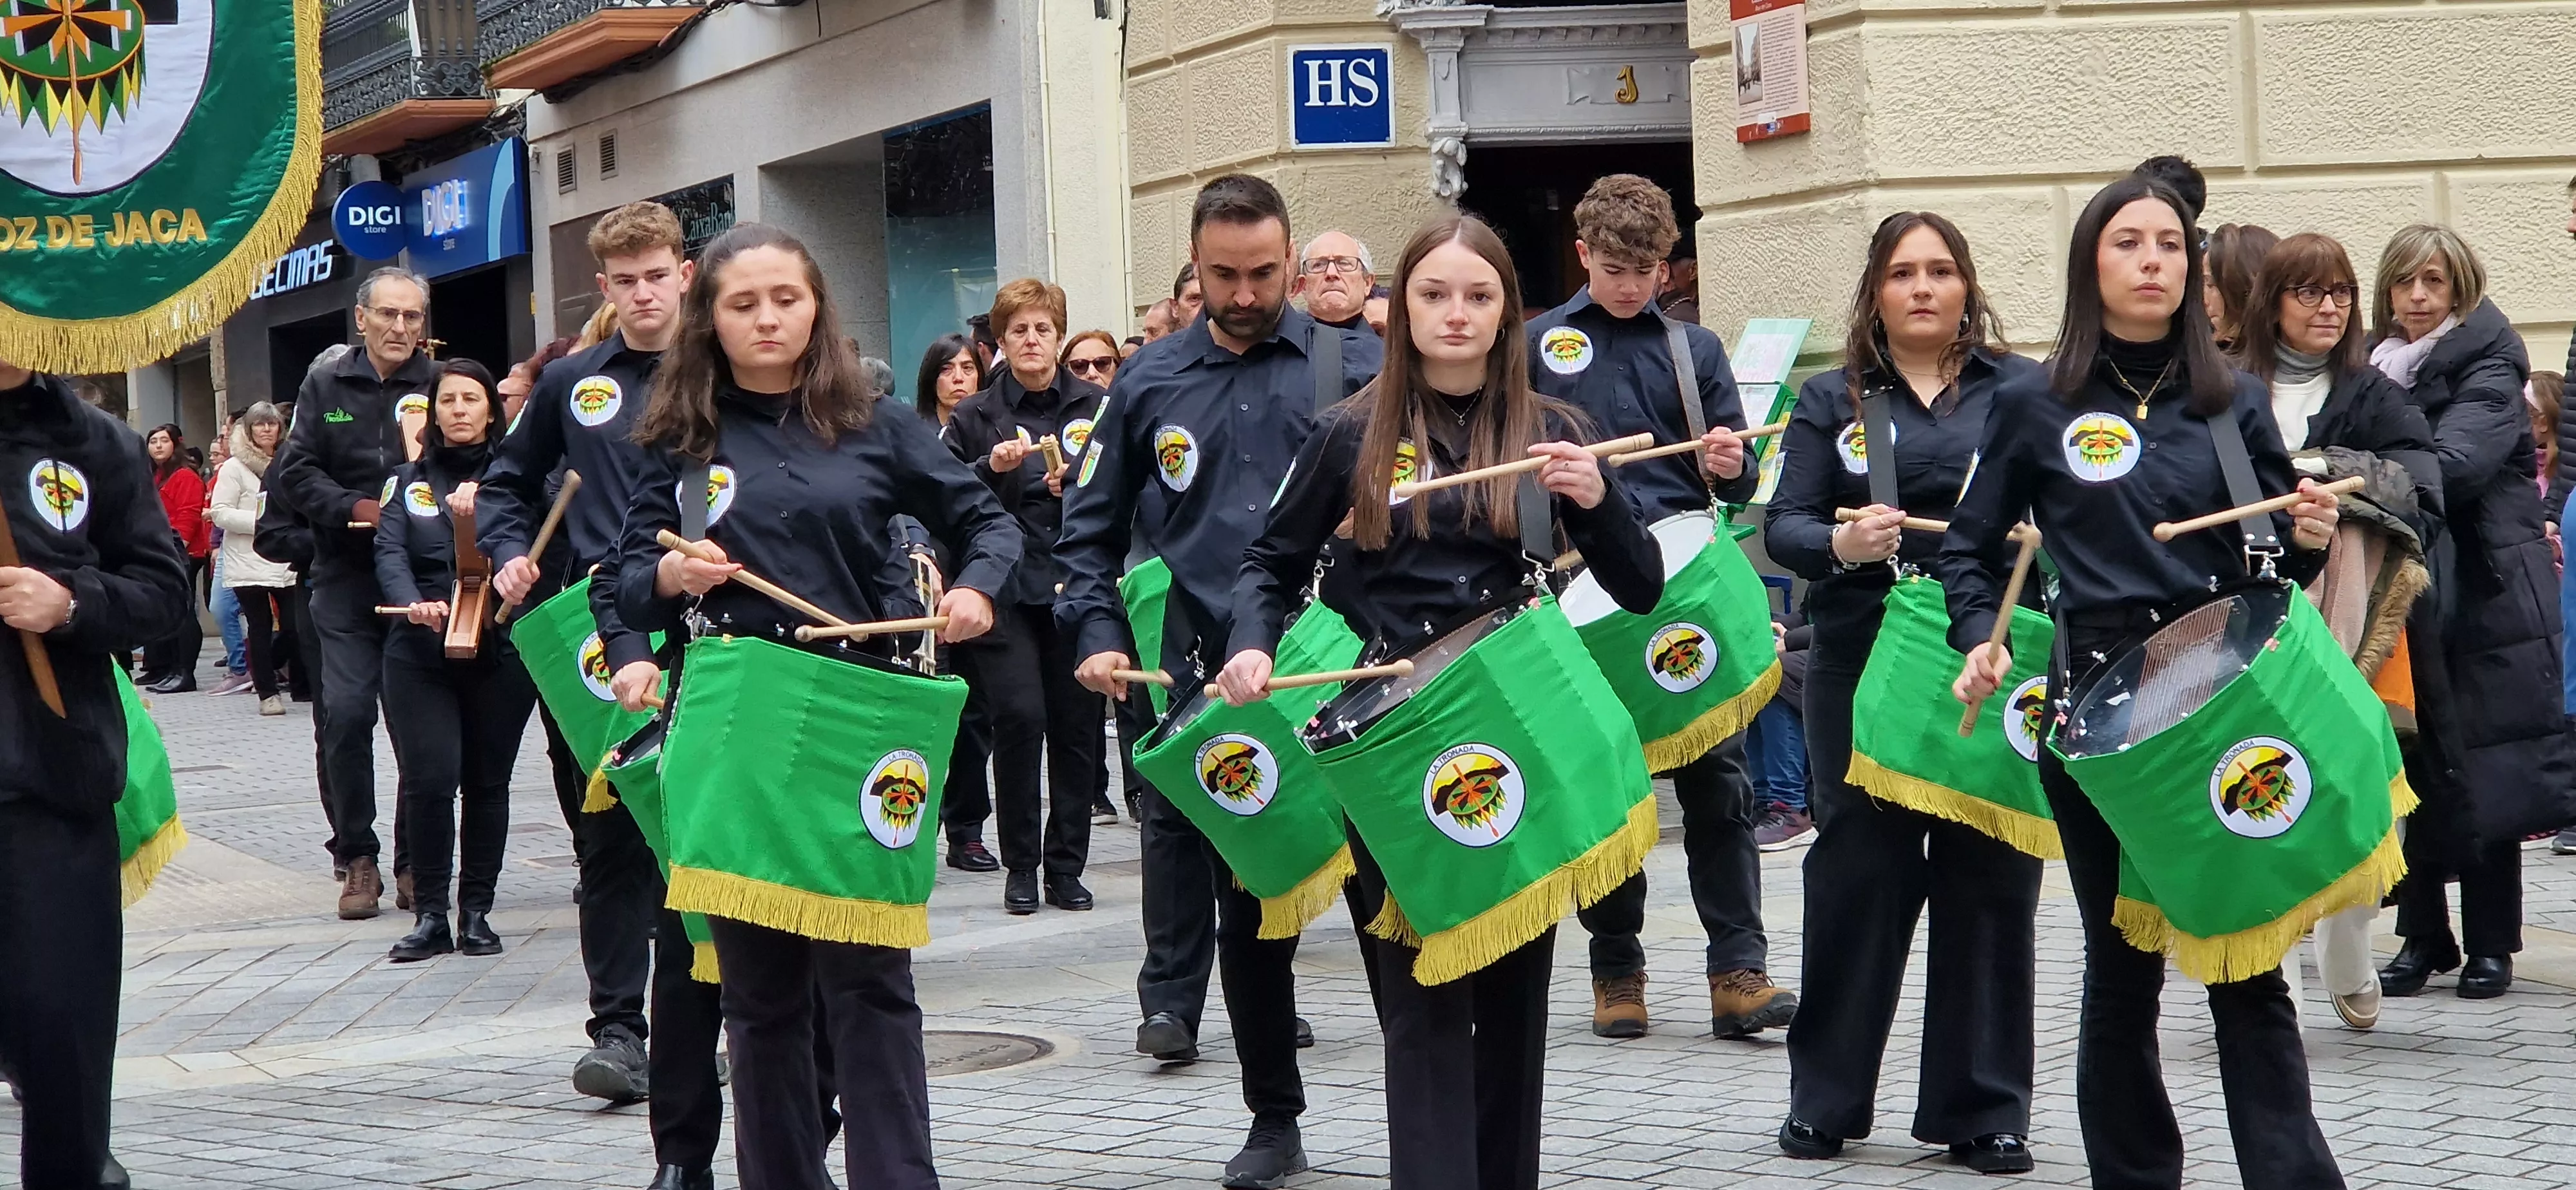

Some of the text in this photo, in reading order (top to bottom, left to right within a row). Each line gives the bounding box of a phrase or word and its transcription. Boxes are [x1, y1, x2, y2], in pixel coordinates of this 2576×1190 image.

[1303, 58, 1379, 107] HS
[348, 205, 401, 225] DIGI
[422, 179, 468, 236] DIGI
[44, 214, 95, 249] DE
[104, 208, 207, 247] JACA
[364, 225, 387, 234] store
[898, 751, 924, 766] TRONADA
[1200, 736, 1225, 754] TRONADA
[1430, 745, 1475, 775] LA TRONADA
[2214, 740, 2255, 777] LA TRONADA
